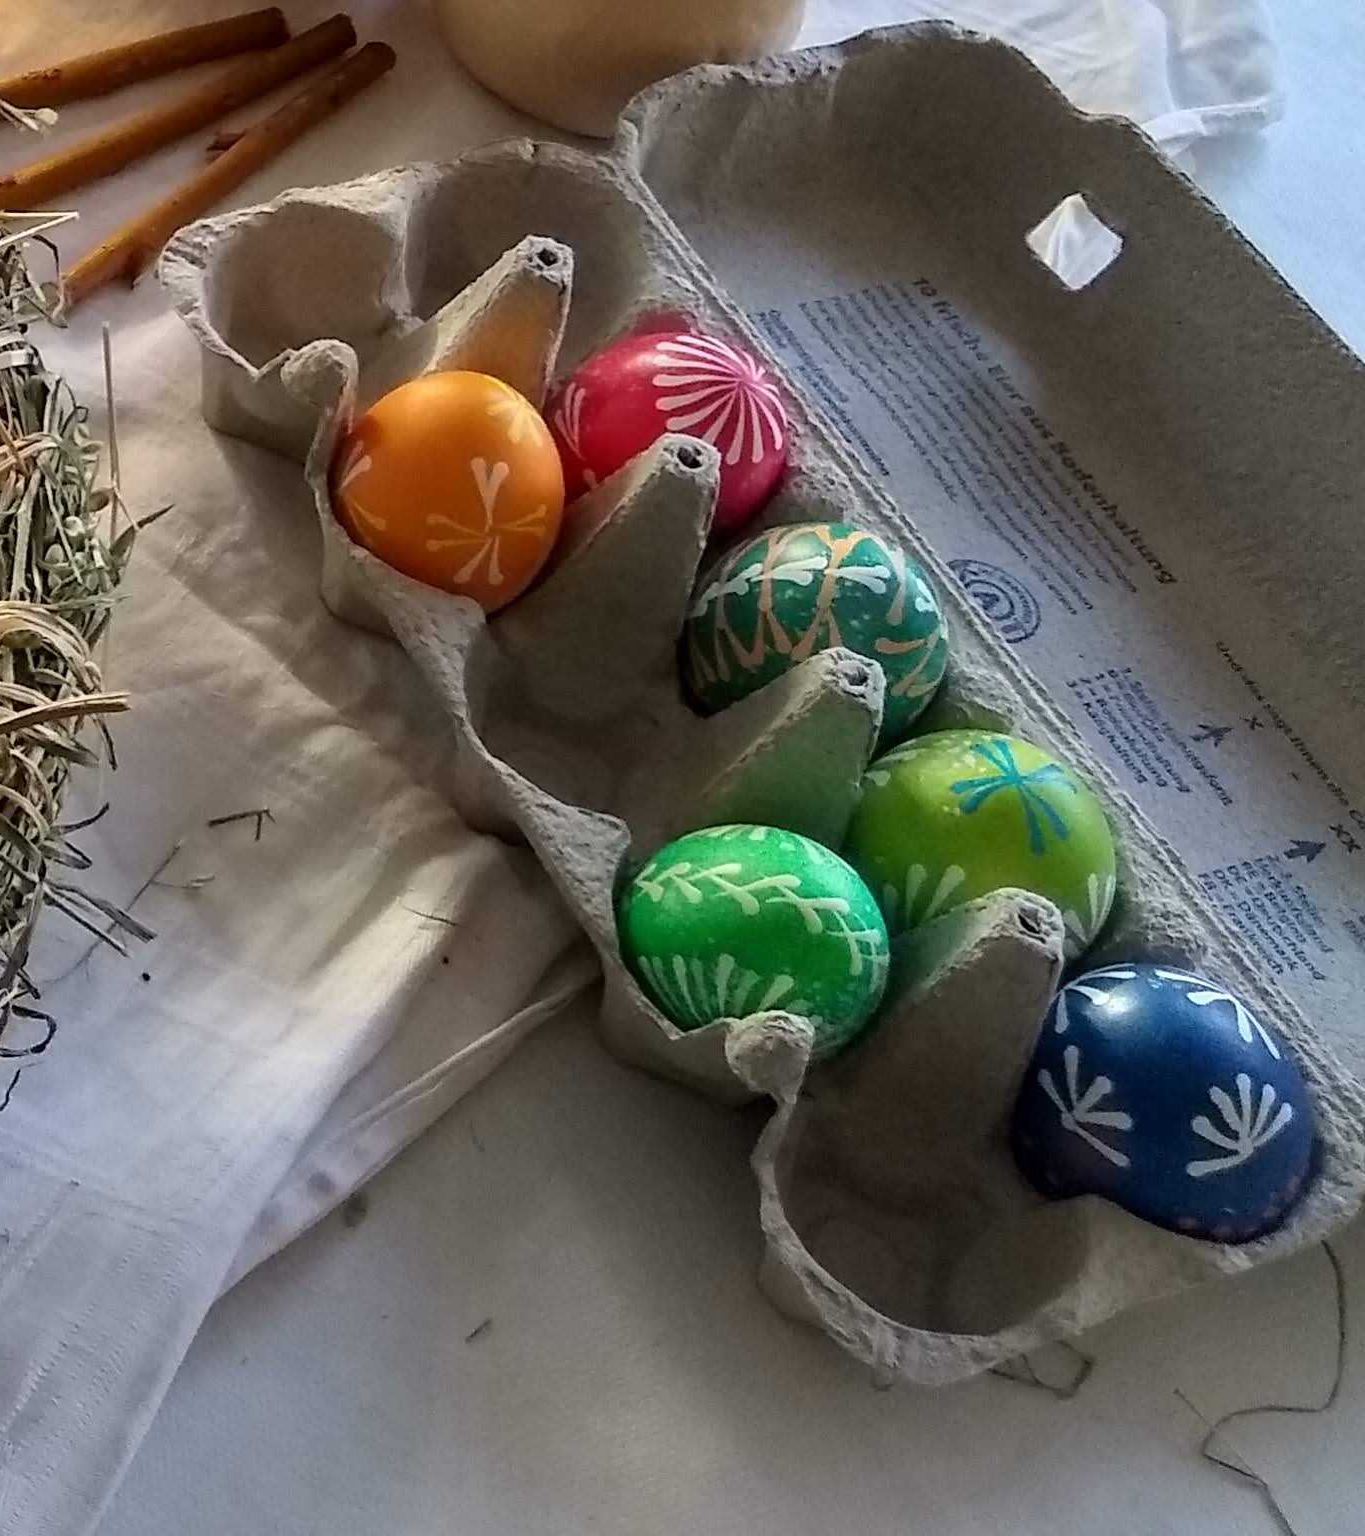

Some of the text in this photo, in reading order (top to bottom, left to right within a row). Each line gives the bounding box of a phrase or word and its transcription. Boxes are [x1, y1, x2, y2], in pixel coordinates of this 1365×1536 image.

[932, 301, 989, 362] frische
[987, 364, 1025, 401] Eier
[1020, 406, 1054, 439] aus
[1050, 442, 1177, 584] Bodenhaltung
[1236, 901, 1299, 971] Dänemark
[1251, 897, 1326, 981] Deutschland
